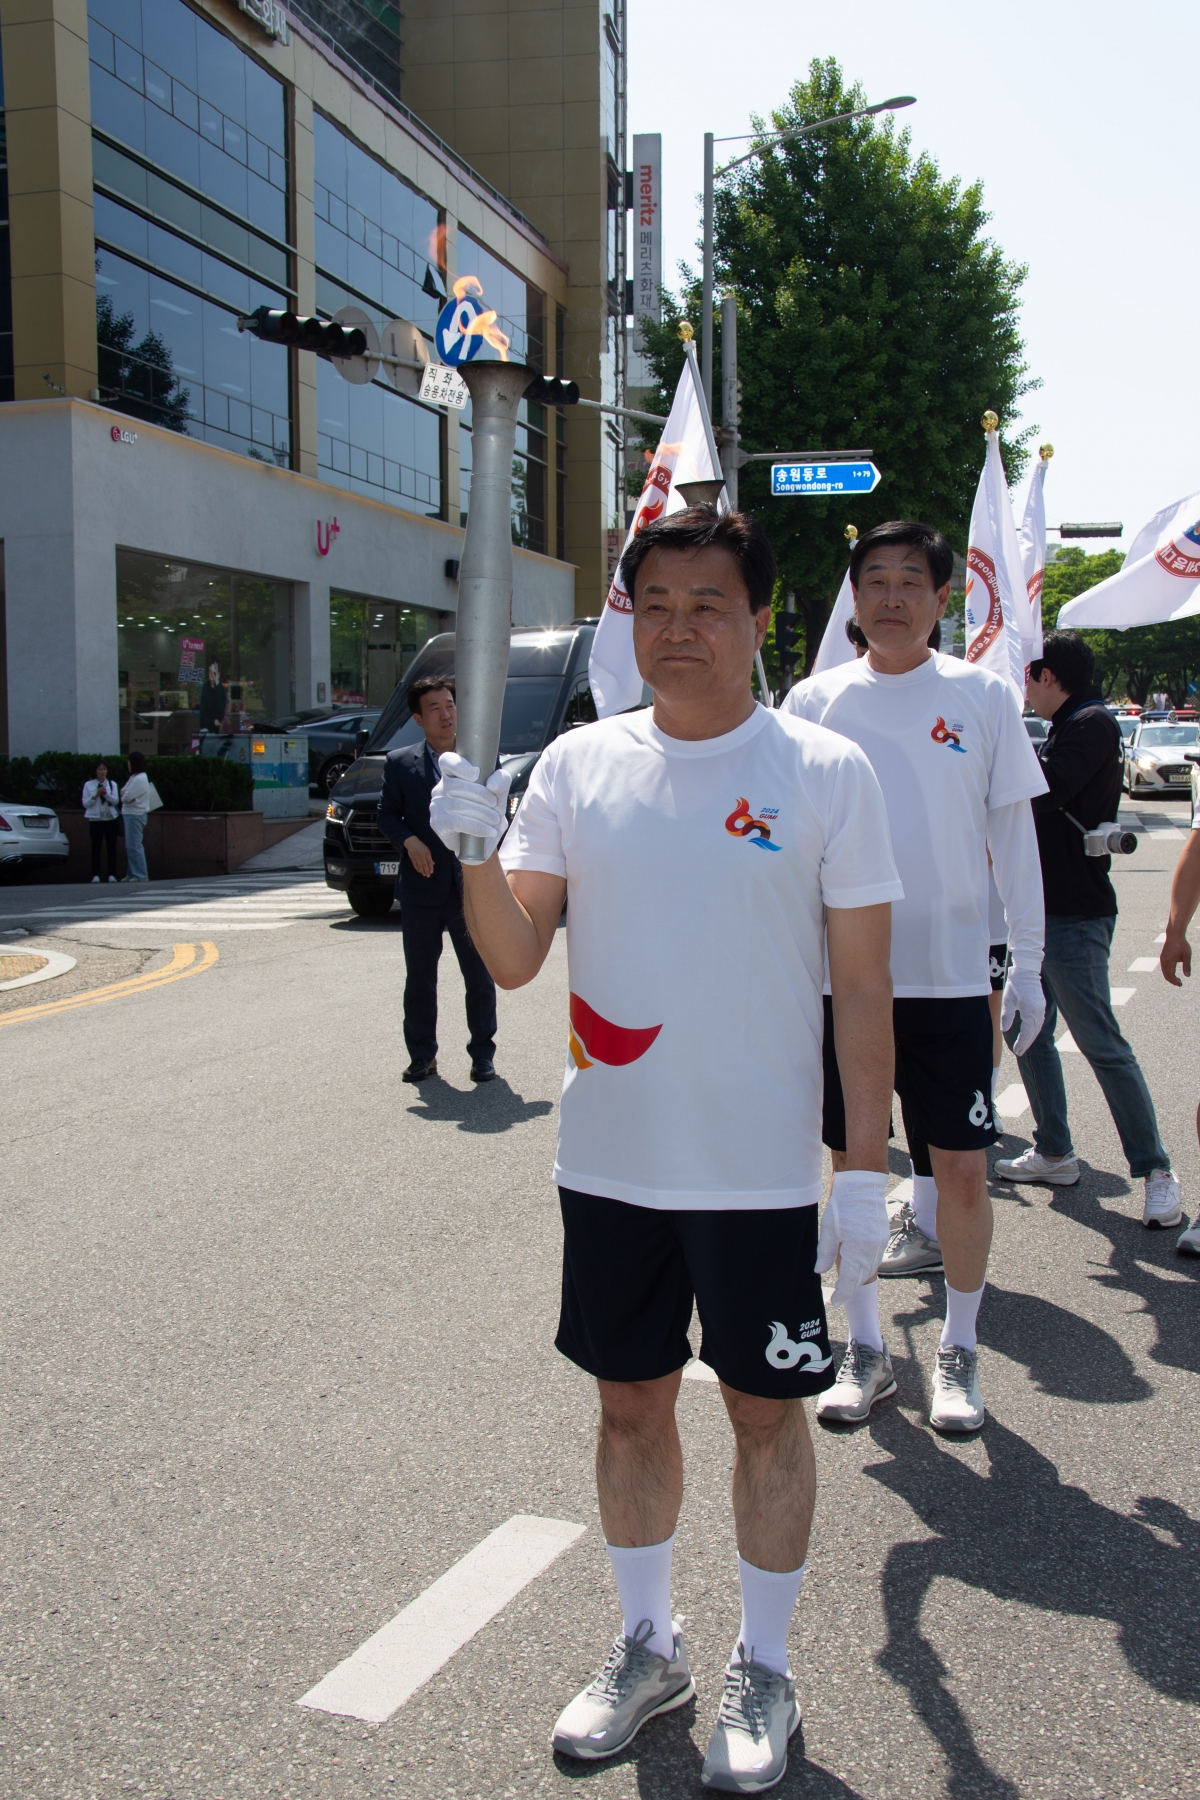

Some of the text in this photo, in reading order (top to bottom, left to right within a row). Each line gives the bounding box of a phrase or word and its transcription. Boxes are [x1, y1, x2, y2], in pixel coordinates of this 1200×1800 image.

[640, 165, 657, 226] meritz
[640, 231, 654, 308] 메리츠화재
[423, 384, 464, 404] 승용차전용
[776, 467, 827, 482] 송원동로
[776, 482, 844, 492] Songwondong-ro
[317, 516, 341, 556] U+
[969, 553, 1000, 599] Gyeongbuk
[986, 601, 1001, 635] Sports
[380, 863, 397, 874] 719
[799, 1318, 820, 1332] 2024
[801, 1326, 821, 1340] GUMI
